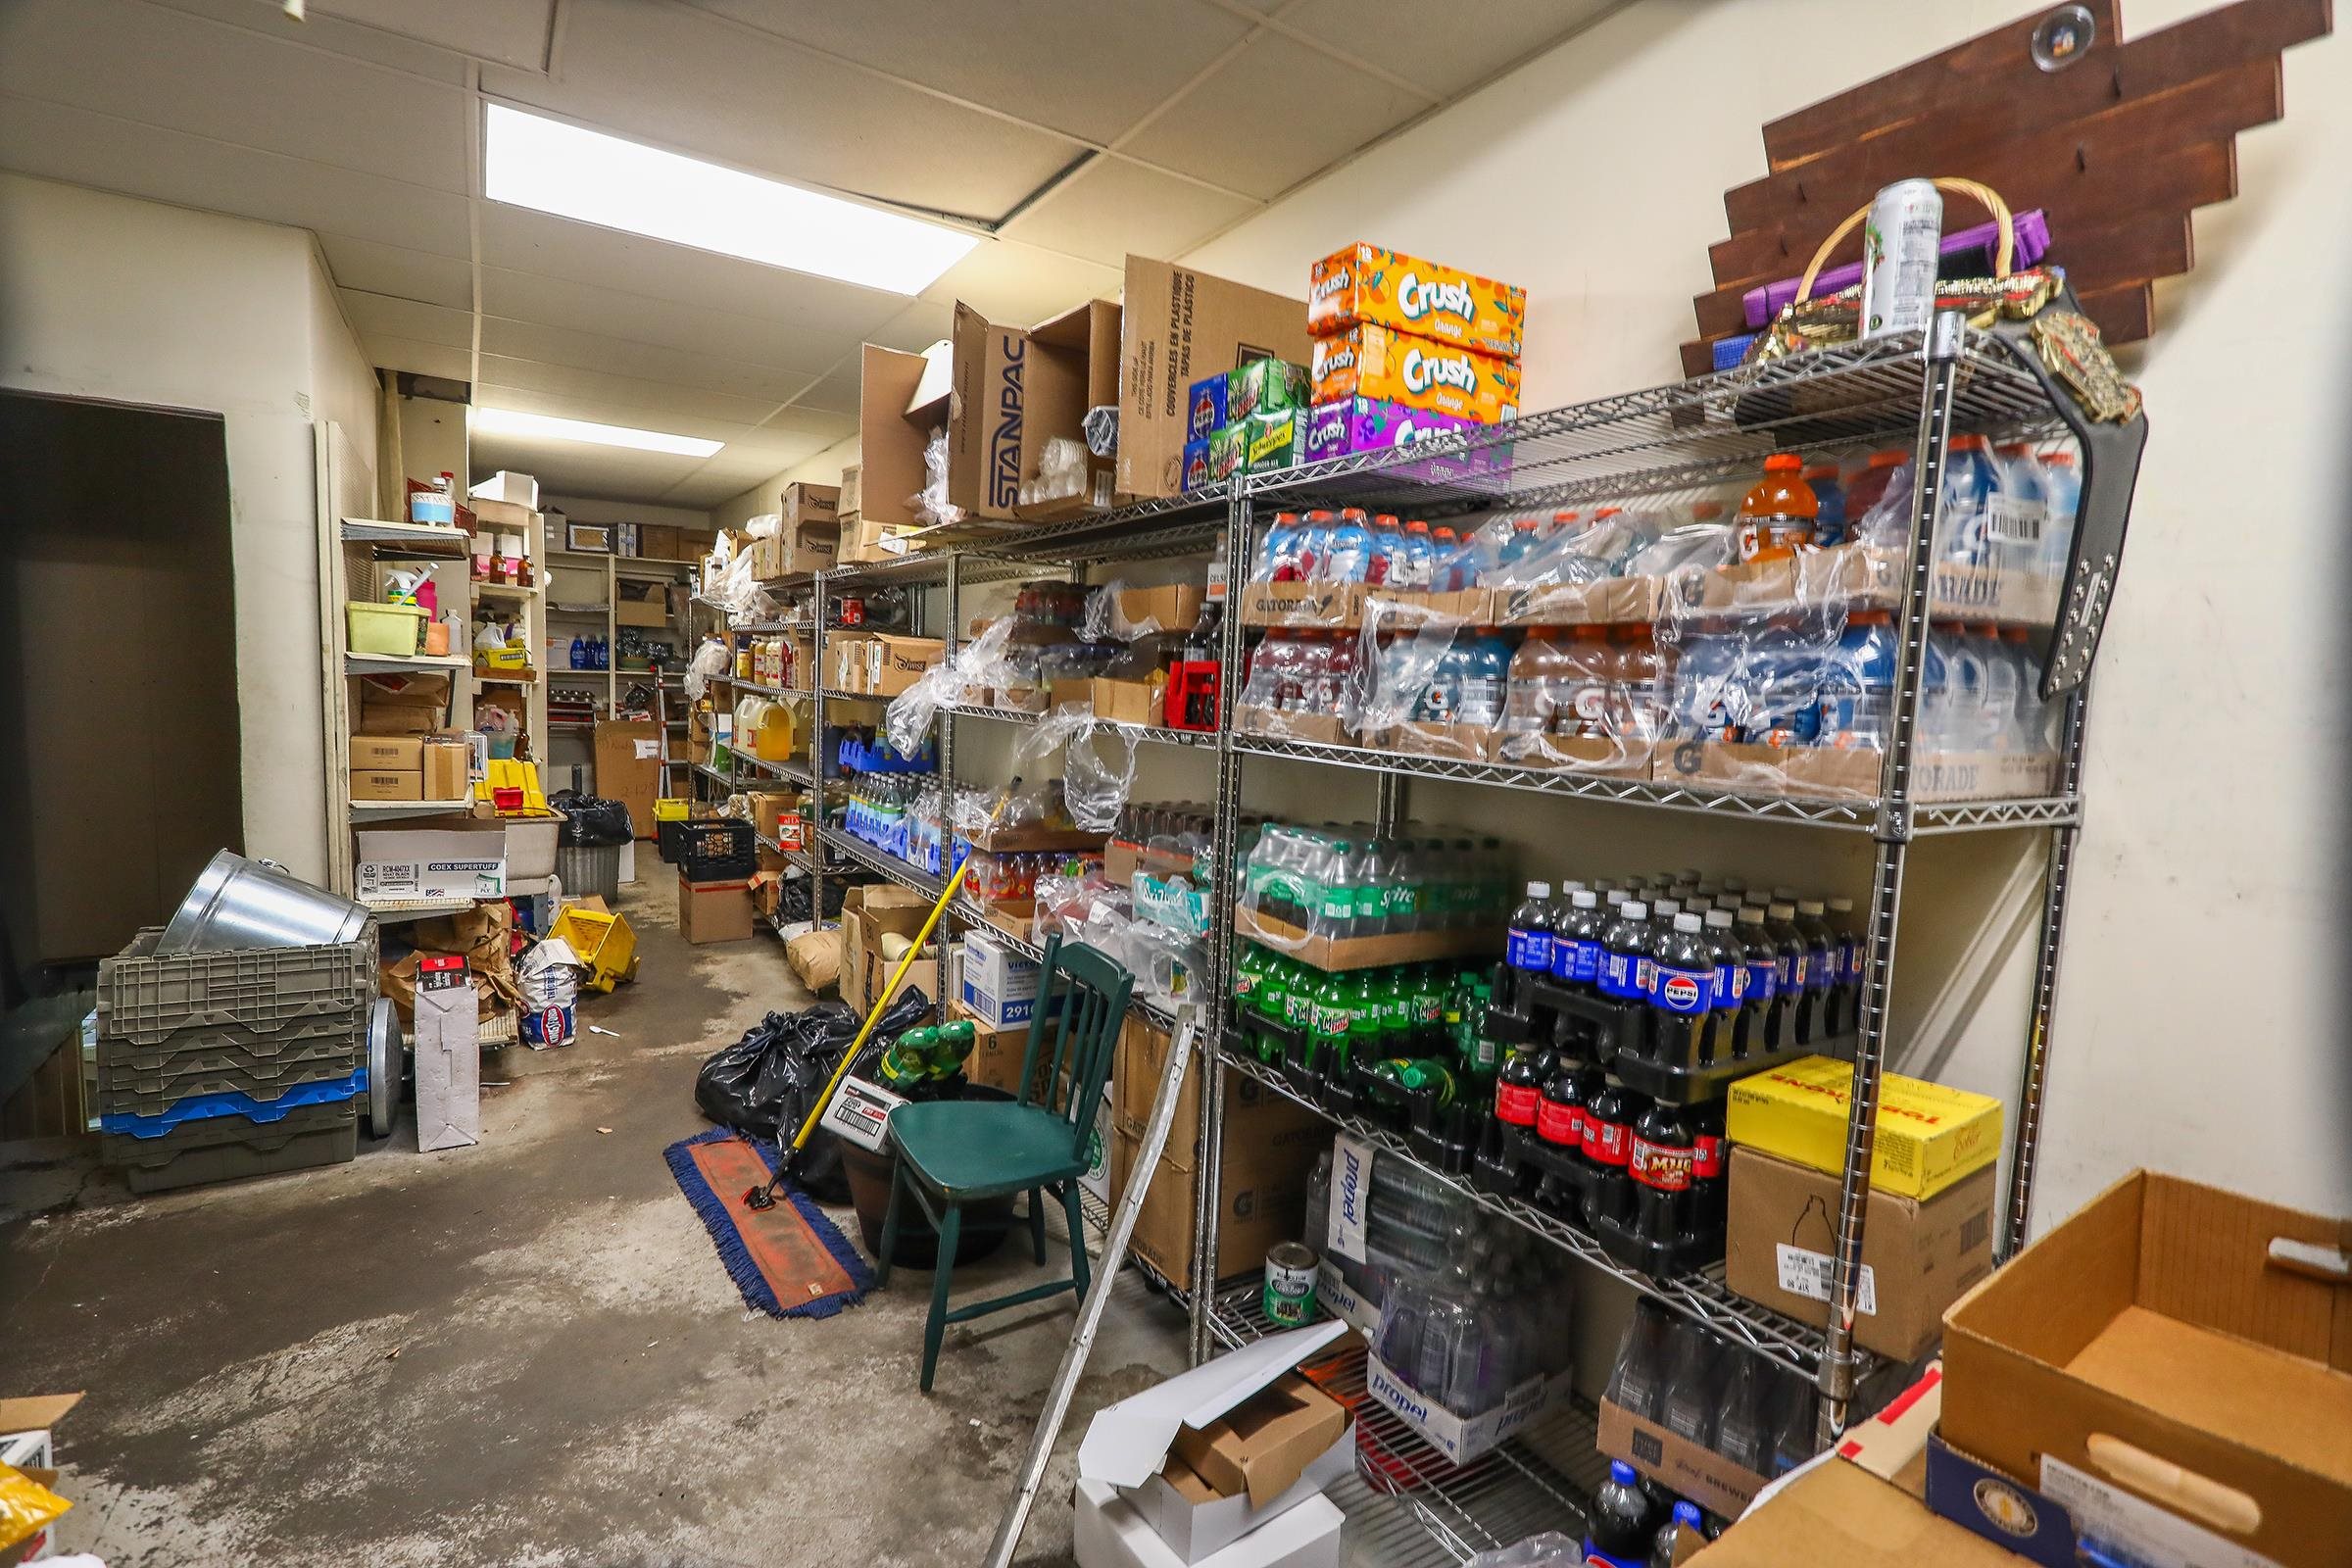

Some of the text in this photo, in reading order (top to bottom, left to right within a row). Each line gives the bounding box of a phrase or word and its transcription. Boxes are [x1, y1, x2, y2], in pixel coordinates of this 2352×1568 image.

[1312, 266, 1351, 302] Crush
[1397, 272, 1476, 320] Crush
[1182, 327, 1192, 343] DE
[1434, 318, 1462, 338] Orange
[1181, 344, 1191, 378] TAPAS
[1312, 342, 1354, 383] Crush
[1402, 348, 1476, 393] Crush
[1436, 392, 1464, 411] Orange
[989, 335, 1025, 510] STANPAC
[1308, 416, 1347, 452] Crush
[1674, 742, 1703, 775] G
[1380, 886, 1415, 907] Sprite
[1666, 987, 1696, 998] PEPSI
[546, 1007, 562, 1044] KINGSFORD
[988, 1035, 998, 1051] 6
[1341, 1148, 1360, 1226] propel
[1372, 1373, 1428, 1423] propel
